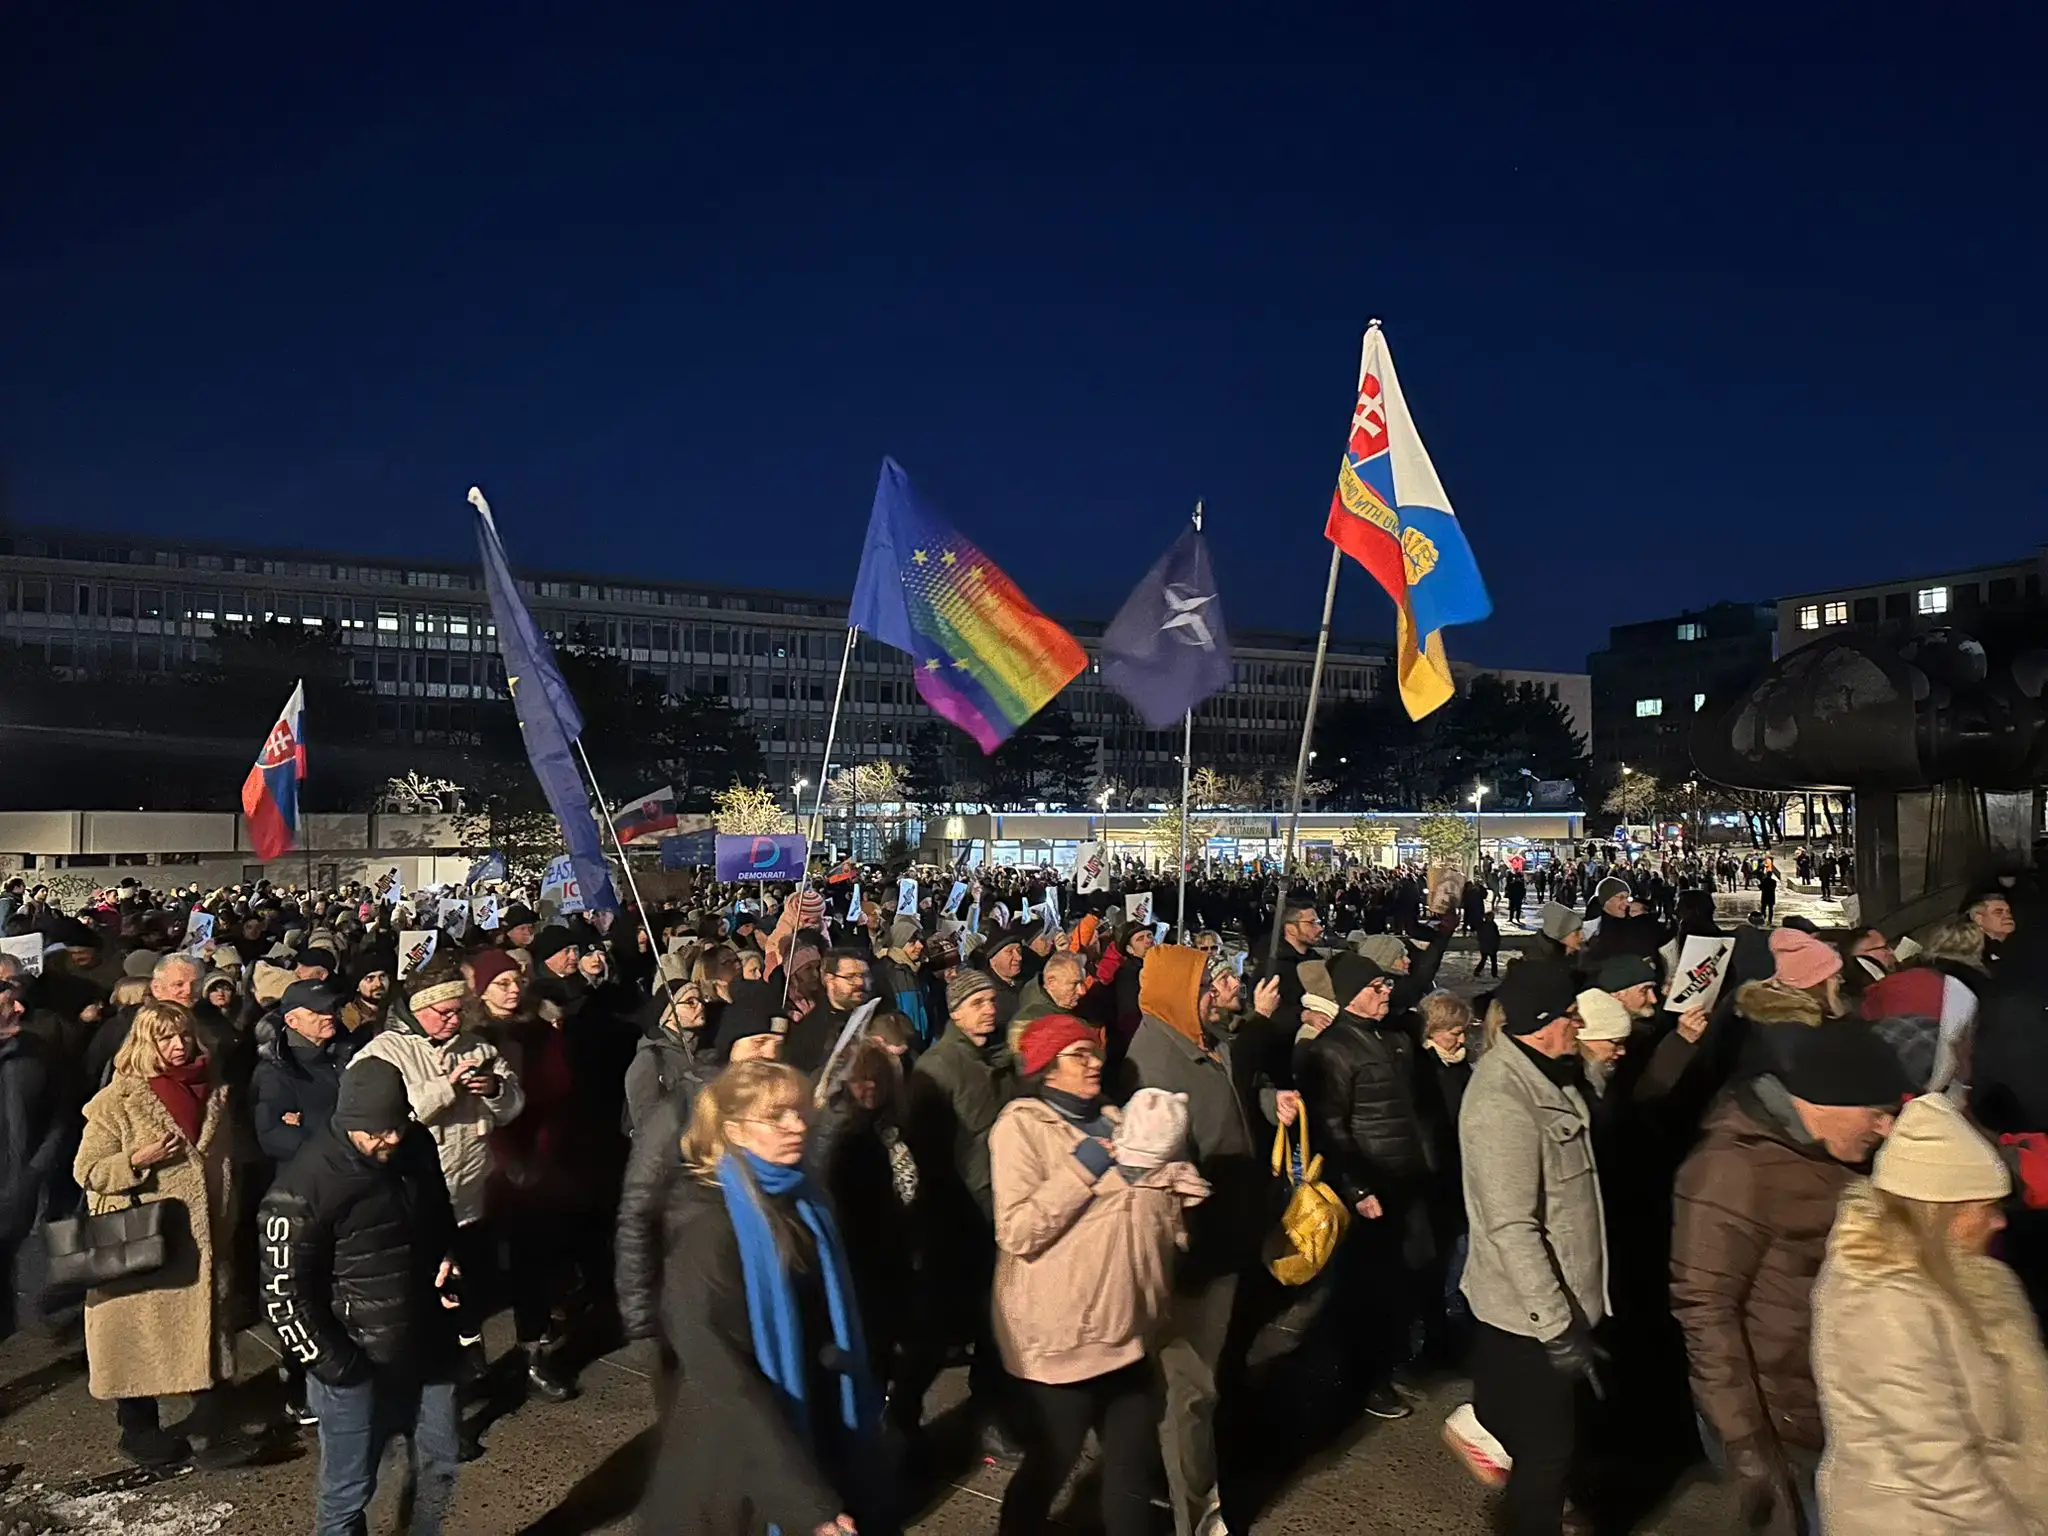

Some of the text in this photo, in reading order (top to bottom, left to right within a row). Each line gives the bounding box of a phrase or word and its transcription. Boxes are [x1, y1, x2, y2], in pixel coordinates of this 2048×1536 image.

[1354, 495, 1384, 520] WITH
[1228, 826, 1269, 835] RESTAURANT
[738, 871, 786, 880] DEMOKRATI
[265, 1215, 319, 1364] SPYDER
